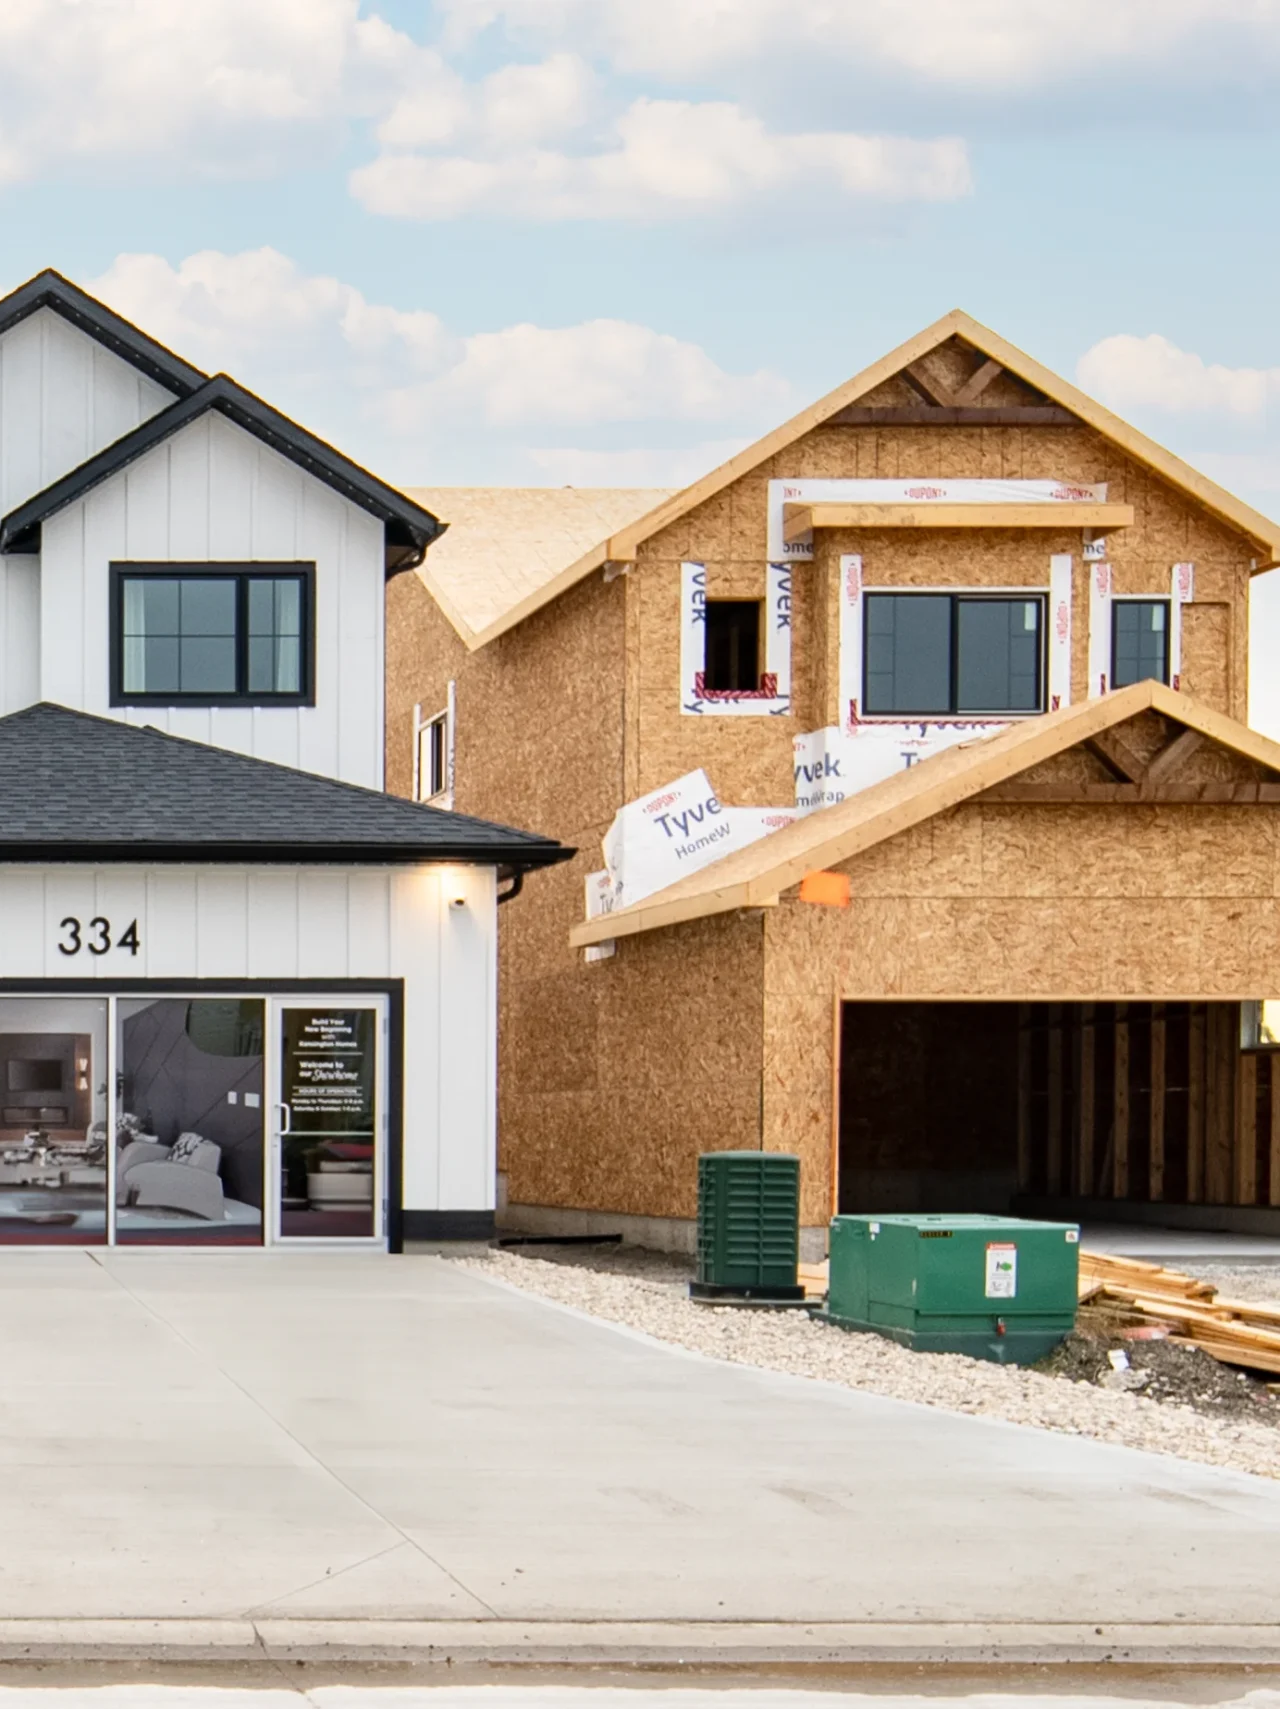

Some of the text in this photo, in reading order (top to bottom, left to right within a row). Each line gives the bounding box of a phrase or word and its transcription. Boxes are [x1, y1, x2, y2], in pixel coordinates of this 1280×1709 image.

[654, 797, 722, 838] Tyve
[674, 823, 731, 859] HomeW
[58, 917, 140, 956] 334
